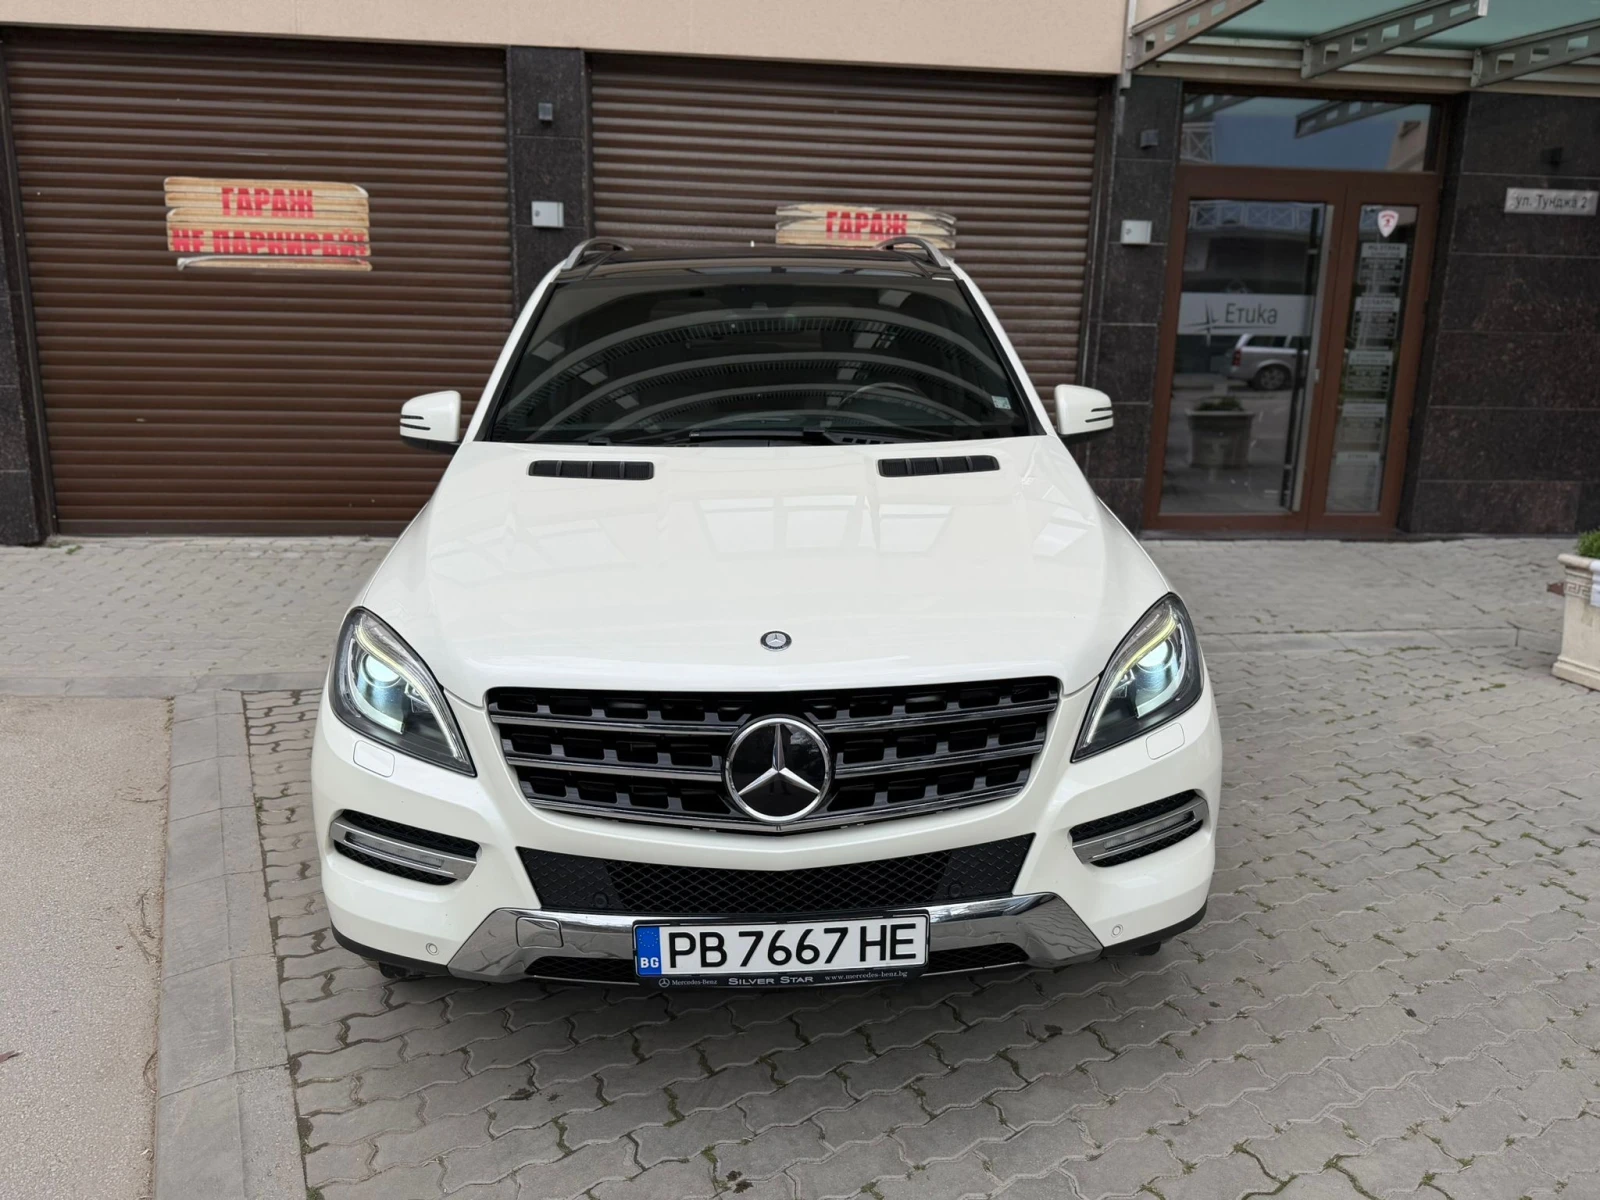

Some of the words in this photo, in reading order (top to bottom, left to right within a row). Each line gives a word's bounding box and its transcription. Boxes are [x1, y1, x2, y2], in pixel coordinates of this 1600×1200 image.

[222, 187, 314, 218] ГАРАЖ
[1514, 196, 1532, 209] ул.
[1581, 196, 1588, 209] 2
[826, 211, 908, 240] ГАРАЖ
[171, 229, 204, 253] НЕ
[640, 956, 659, 969] BG
[671, 978, 718, 986] Mercedes-Benz
[728, 977, 775, 986] SILVER
[780, 975, 814, 984] STAR
[824, 969, 908, 981] www.mercedes-benz.bg
